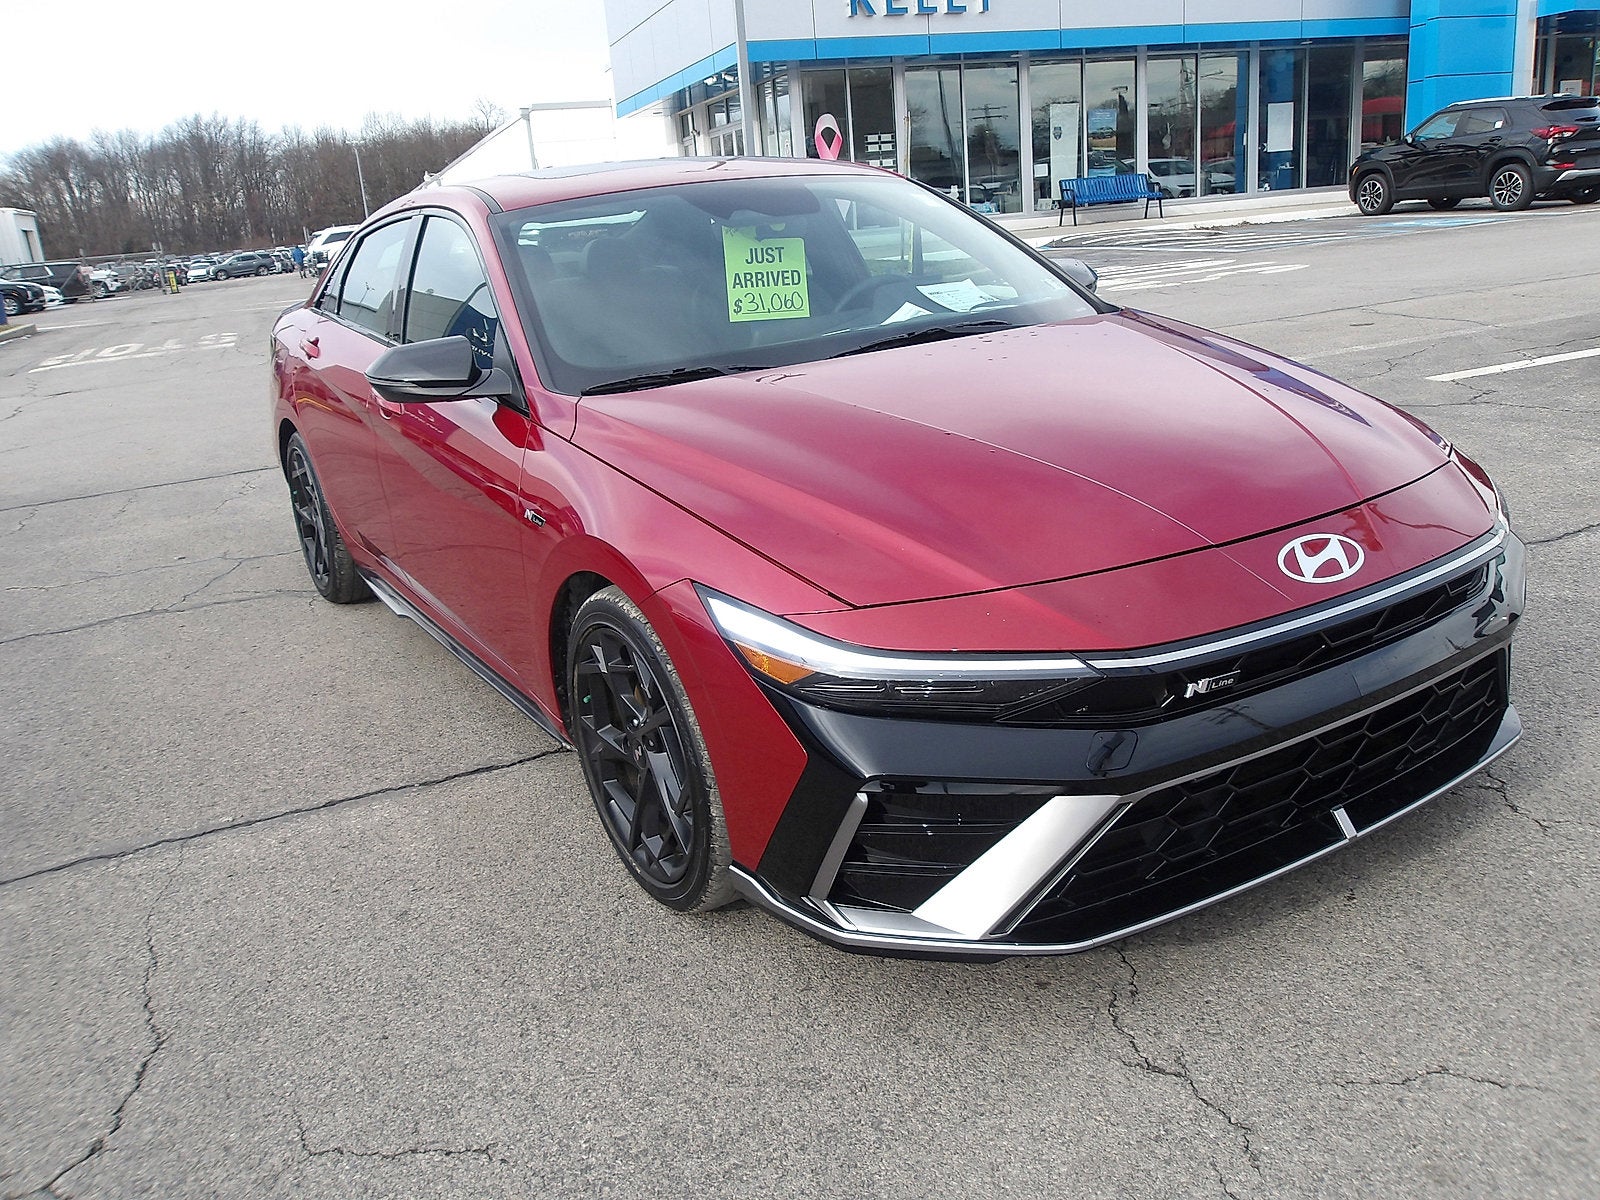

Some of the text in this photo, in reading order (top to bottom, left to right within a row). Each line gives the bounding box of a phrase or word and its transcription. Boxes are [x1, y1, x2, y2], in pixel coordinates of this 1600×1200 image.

[745, 246, 784, 264] JUST
[732, 269, 801, 289] ARRIVED
[733, 291, 804, 315] $31,060
